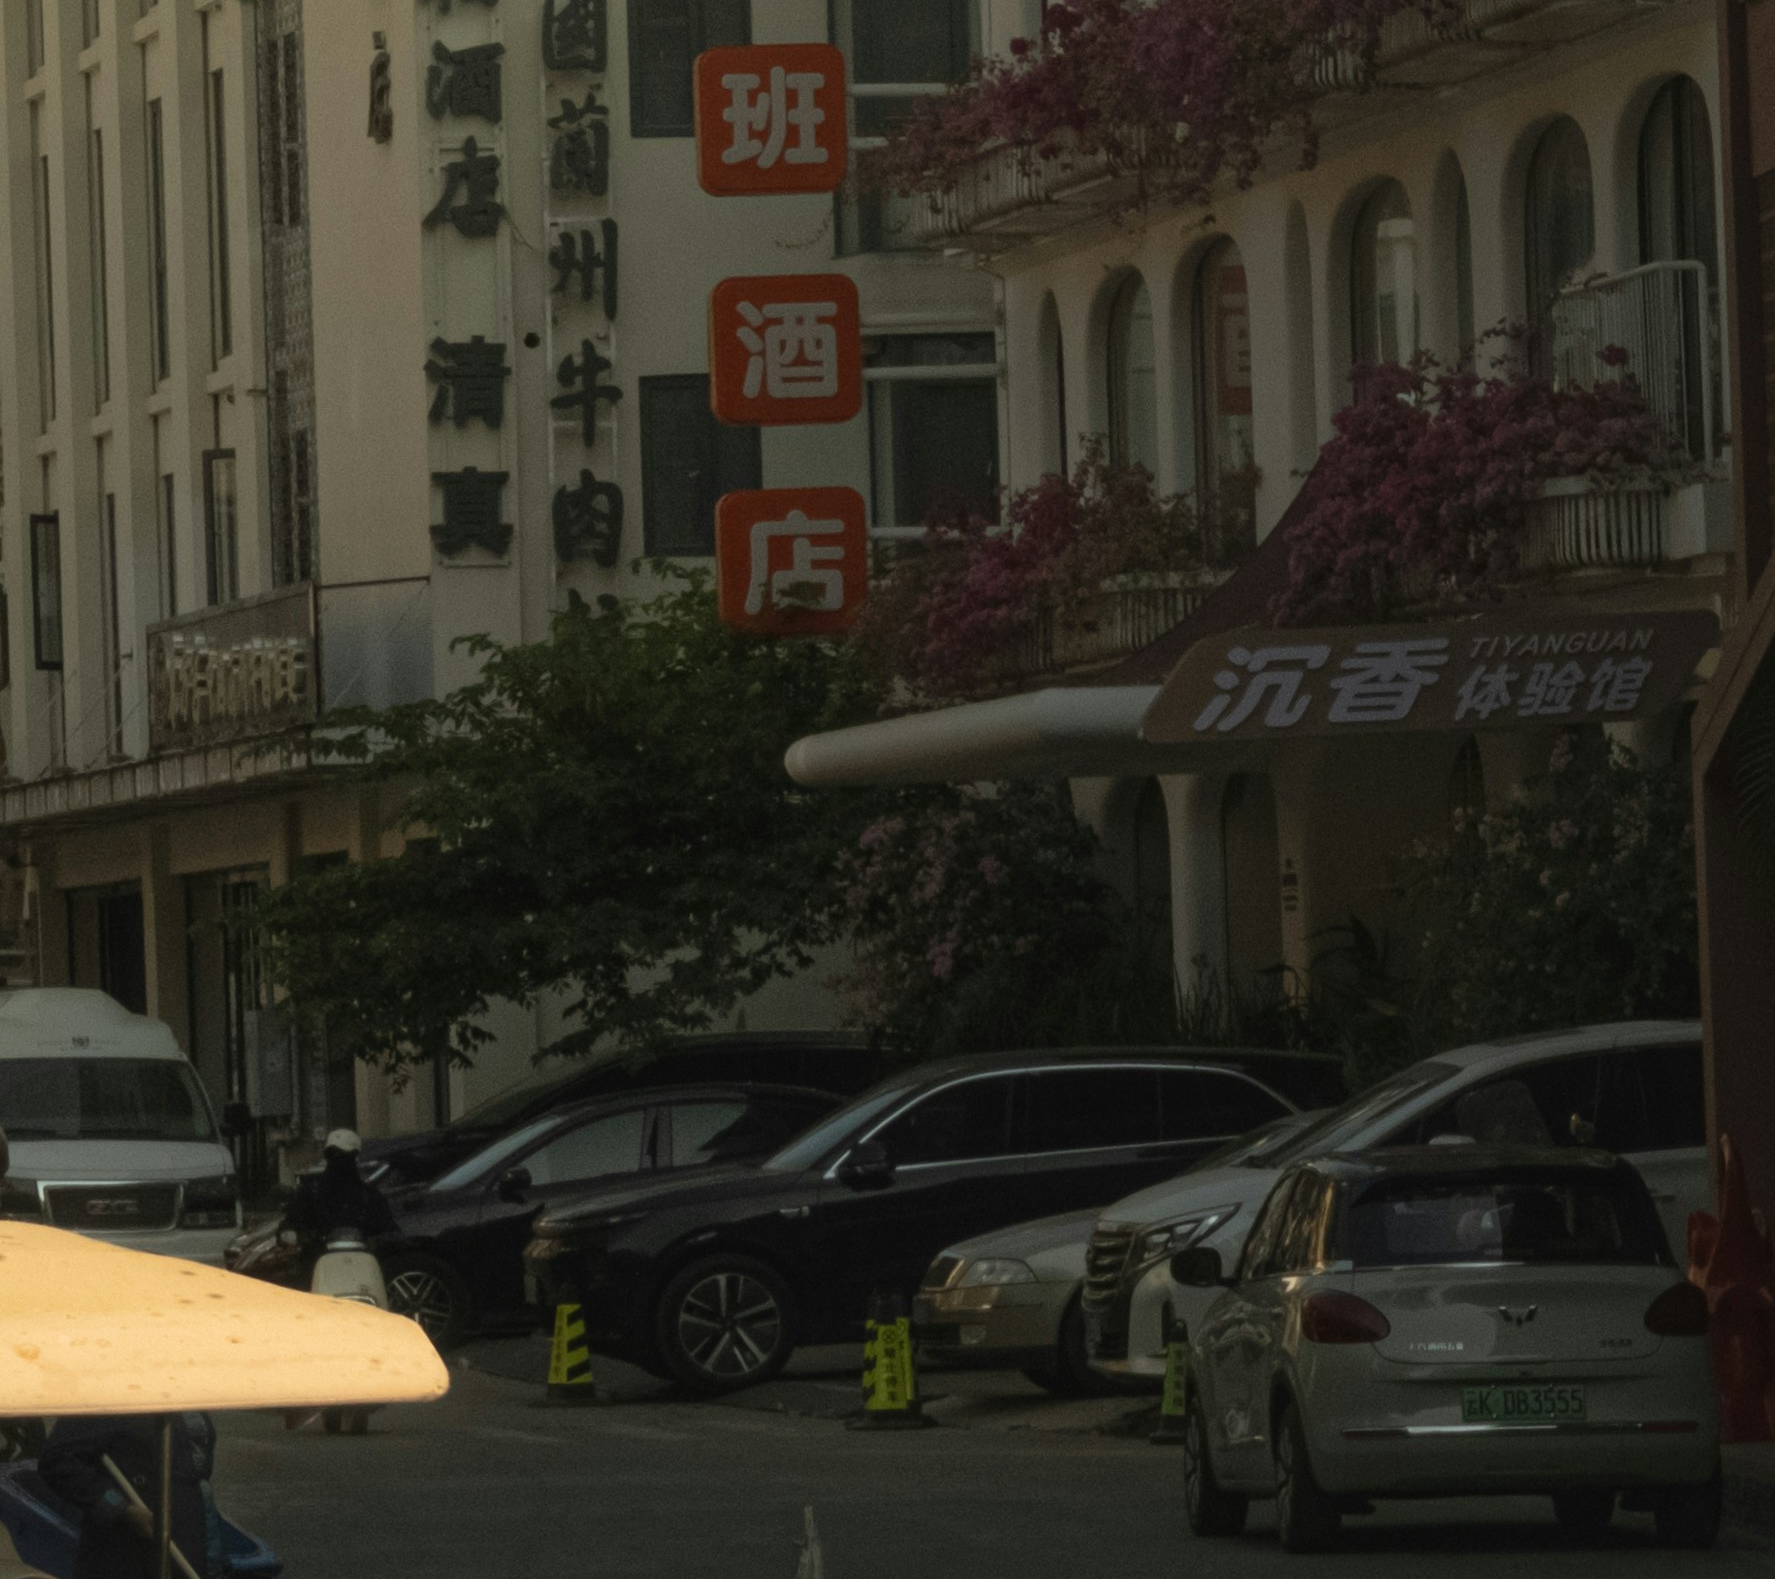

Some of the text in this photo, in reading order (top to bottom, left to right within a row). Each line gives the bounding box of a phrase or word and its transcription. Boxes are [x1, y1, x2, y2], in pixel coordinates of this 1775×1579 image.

[424, 335, 514, 558] 清真
[1192, 637, 1653, 733] 沉香 体验馆
[1470, 628, 1654, 660] TIYANGUAN
